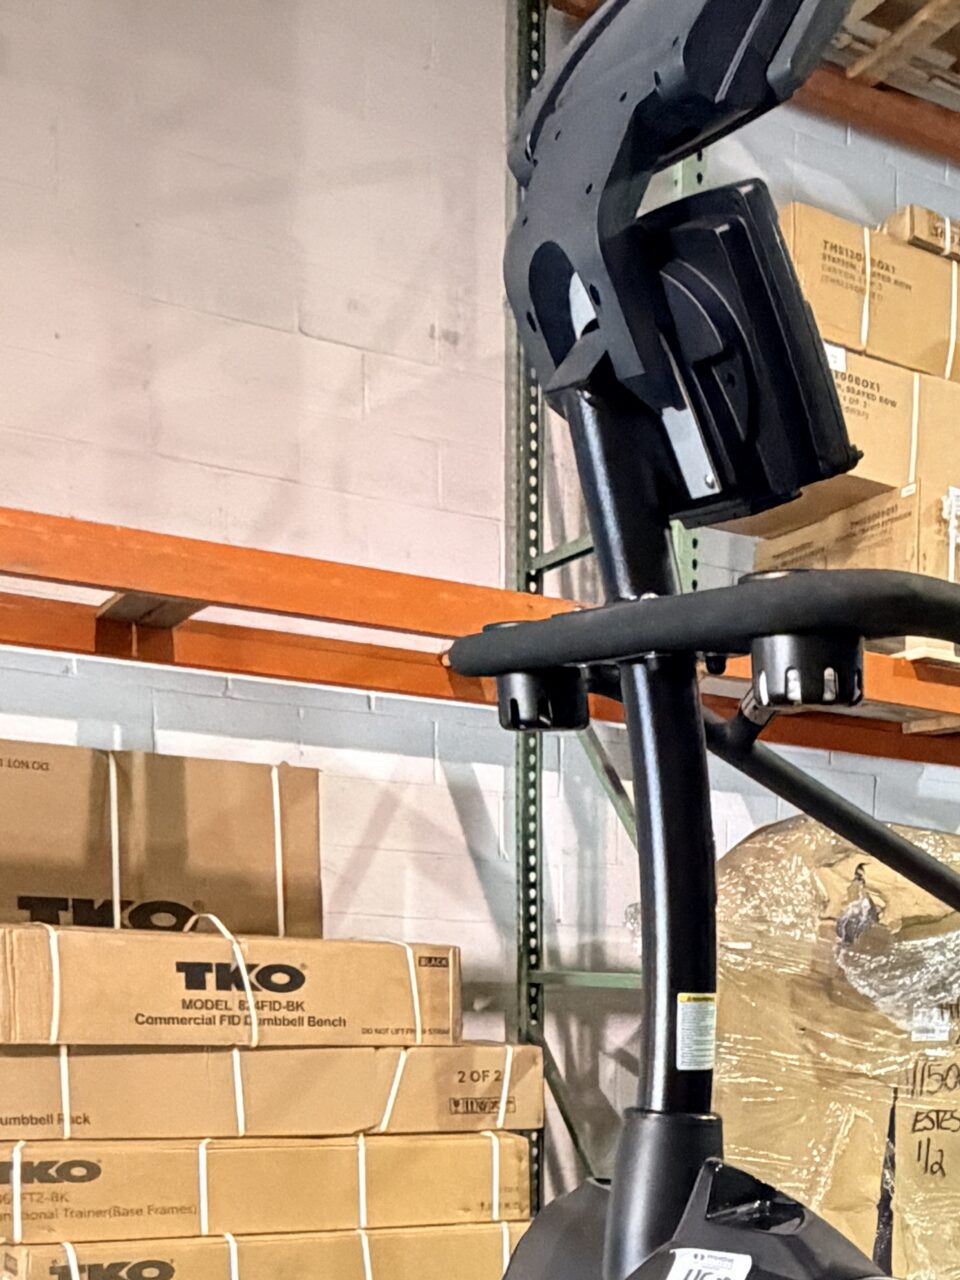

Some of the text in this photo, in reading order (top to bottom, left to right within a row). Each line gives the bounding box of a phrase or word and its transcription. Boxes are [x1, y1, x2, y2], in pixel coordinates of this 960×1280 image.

[176, 961, 306, 993] TKO
[181, 999, 305, 1012] MODEL 84FID-BK
[135, 1012, 216, 1026] Commercial
[219, 1013, 241, 1026] FID
[307, 1016, 347, 1028] Bench
[457, 1070, 502, 1083] 2 OF 2
